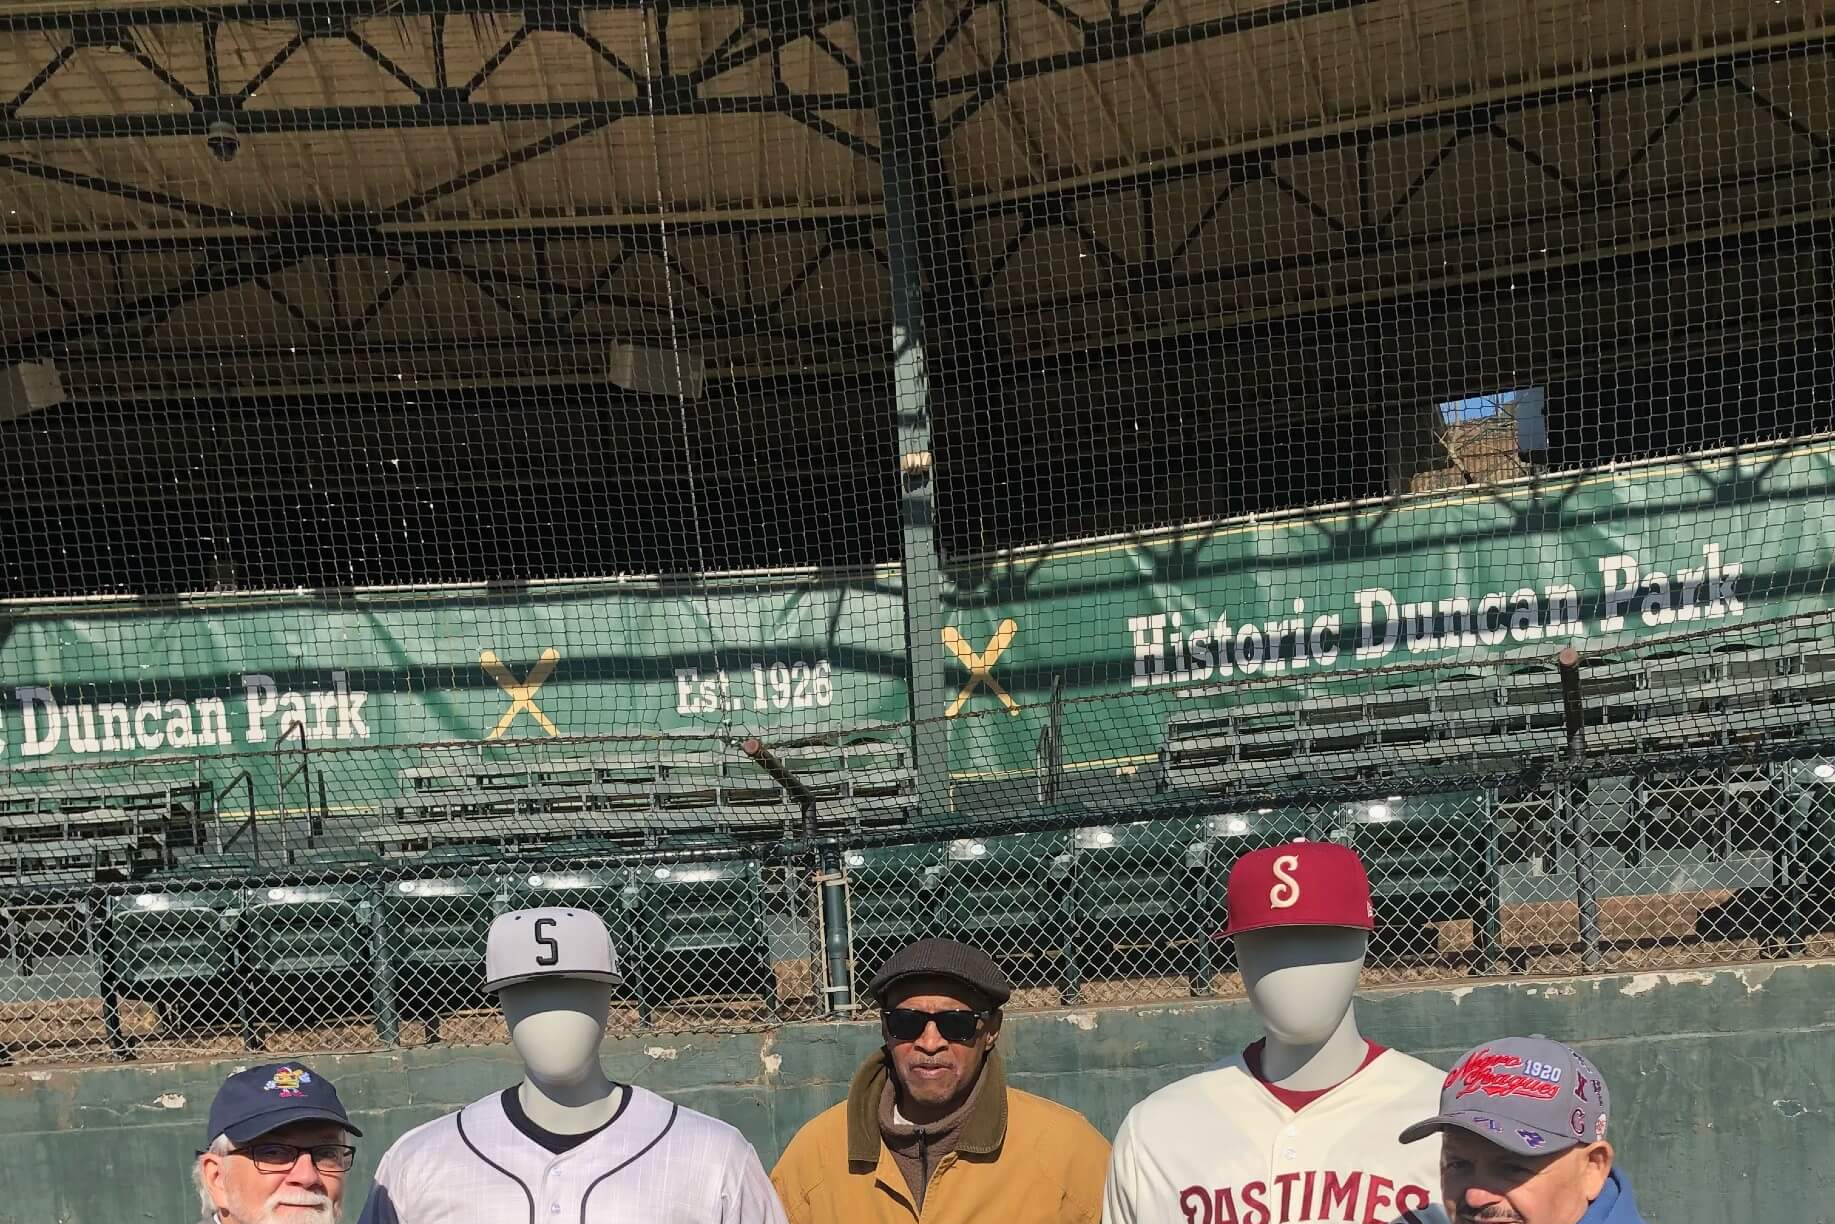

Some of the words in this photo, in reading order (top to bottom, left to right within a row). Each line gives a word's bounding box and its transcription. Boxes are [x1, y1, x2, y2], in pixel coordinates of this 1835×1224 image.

[1128, 597, 1341, 687] Historic
[1354, 583, 1584, 661] Duncan
[1599, 543, 1744, 632] Park
[16, 687, 232, 756] Duncan
[242, 670, 370, 743] Park
[675, 667, 743, 714] Est.
[751, 660, 833, 710] 1926
[1270, 855, 1300, 909] S
[535, 918, 559, 966] S
[1524, 1059, 1561, 1083] 1920
